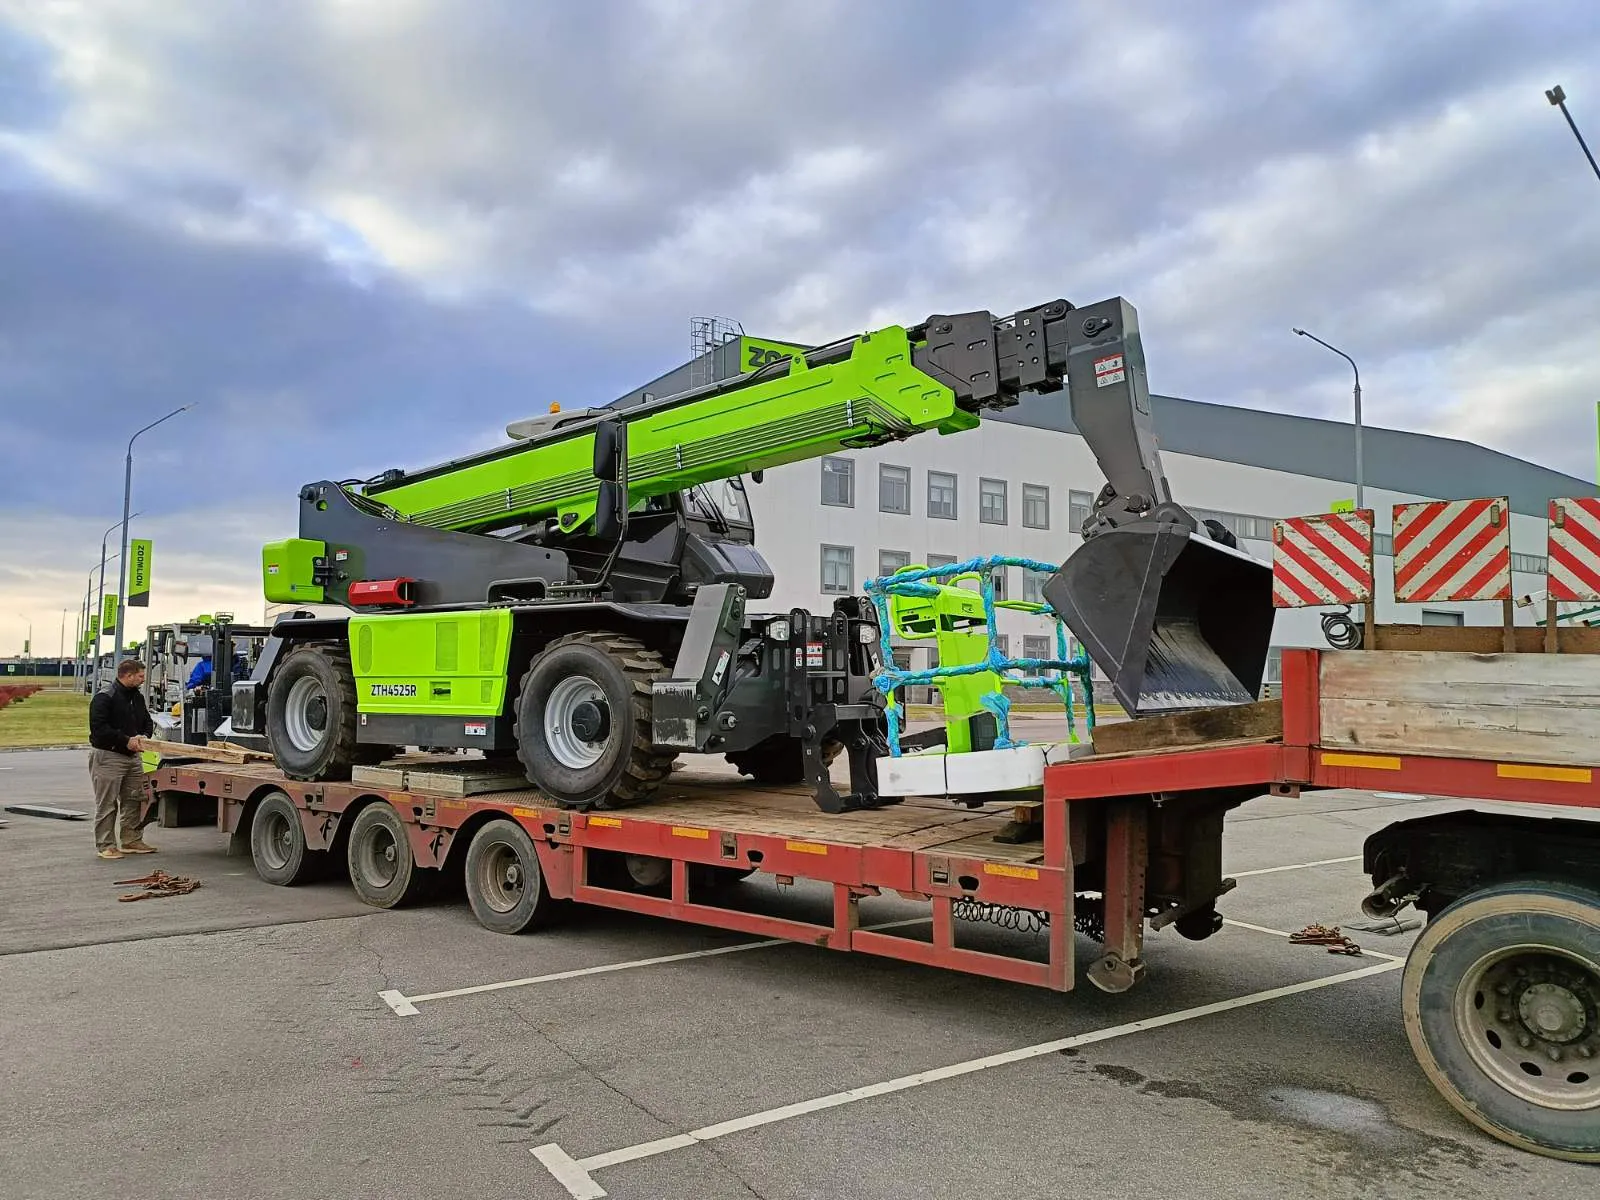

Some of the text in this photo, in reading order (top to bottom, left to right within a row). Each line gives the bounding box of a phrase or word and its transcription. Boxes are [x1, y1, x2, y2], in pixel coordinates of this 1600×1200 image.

[748, 346, 793, 368] ZO
[136, 545, 145, 586] ZOOMLION
[371, 684, 417, 697] ZTH4525R
